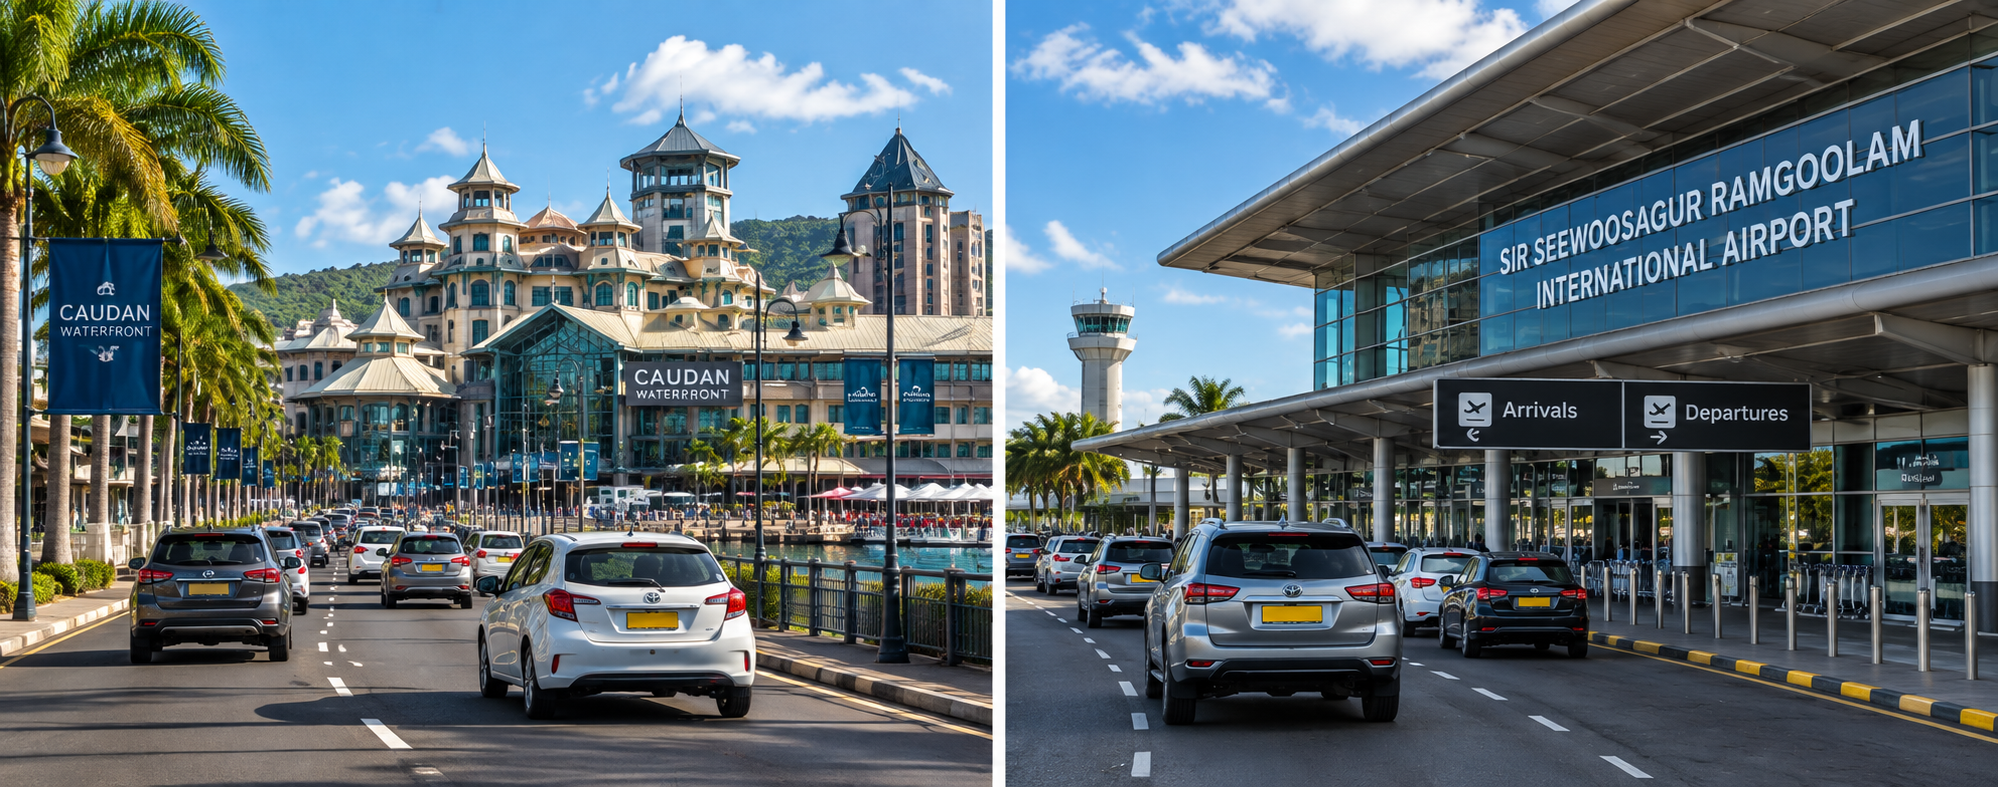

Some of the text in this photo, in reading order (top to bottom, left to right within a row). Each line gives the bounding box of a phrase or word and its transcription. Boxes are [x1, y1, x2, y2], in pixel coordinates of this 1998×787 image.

[1500, 119, 1922, 275] SIR SEEWOOSAGUR RAMGOOLAM
[1537, 198, 1855, 310] INTERNATIONAL AIRPORT
[60, 304, 150, 321] CAUDAN
[60, 326, 152, 337] WATERFRONT
[634, 369, 730, 385] CAUDAN
[1502, 401, 1578, 419] Arrivals
[1685, 404, 1789, 424] Departures
